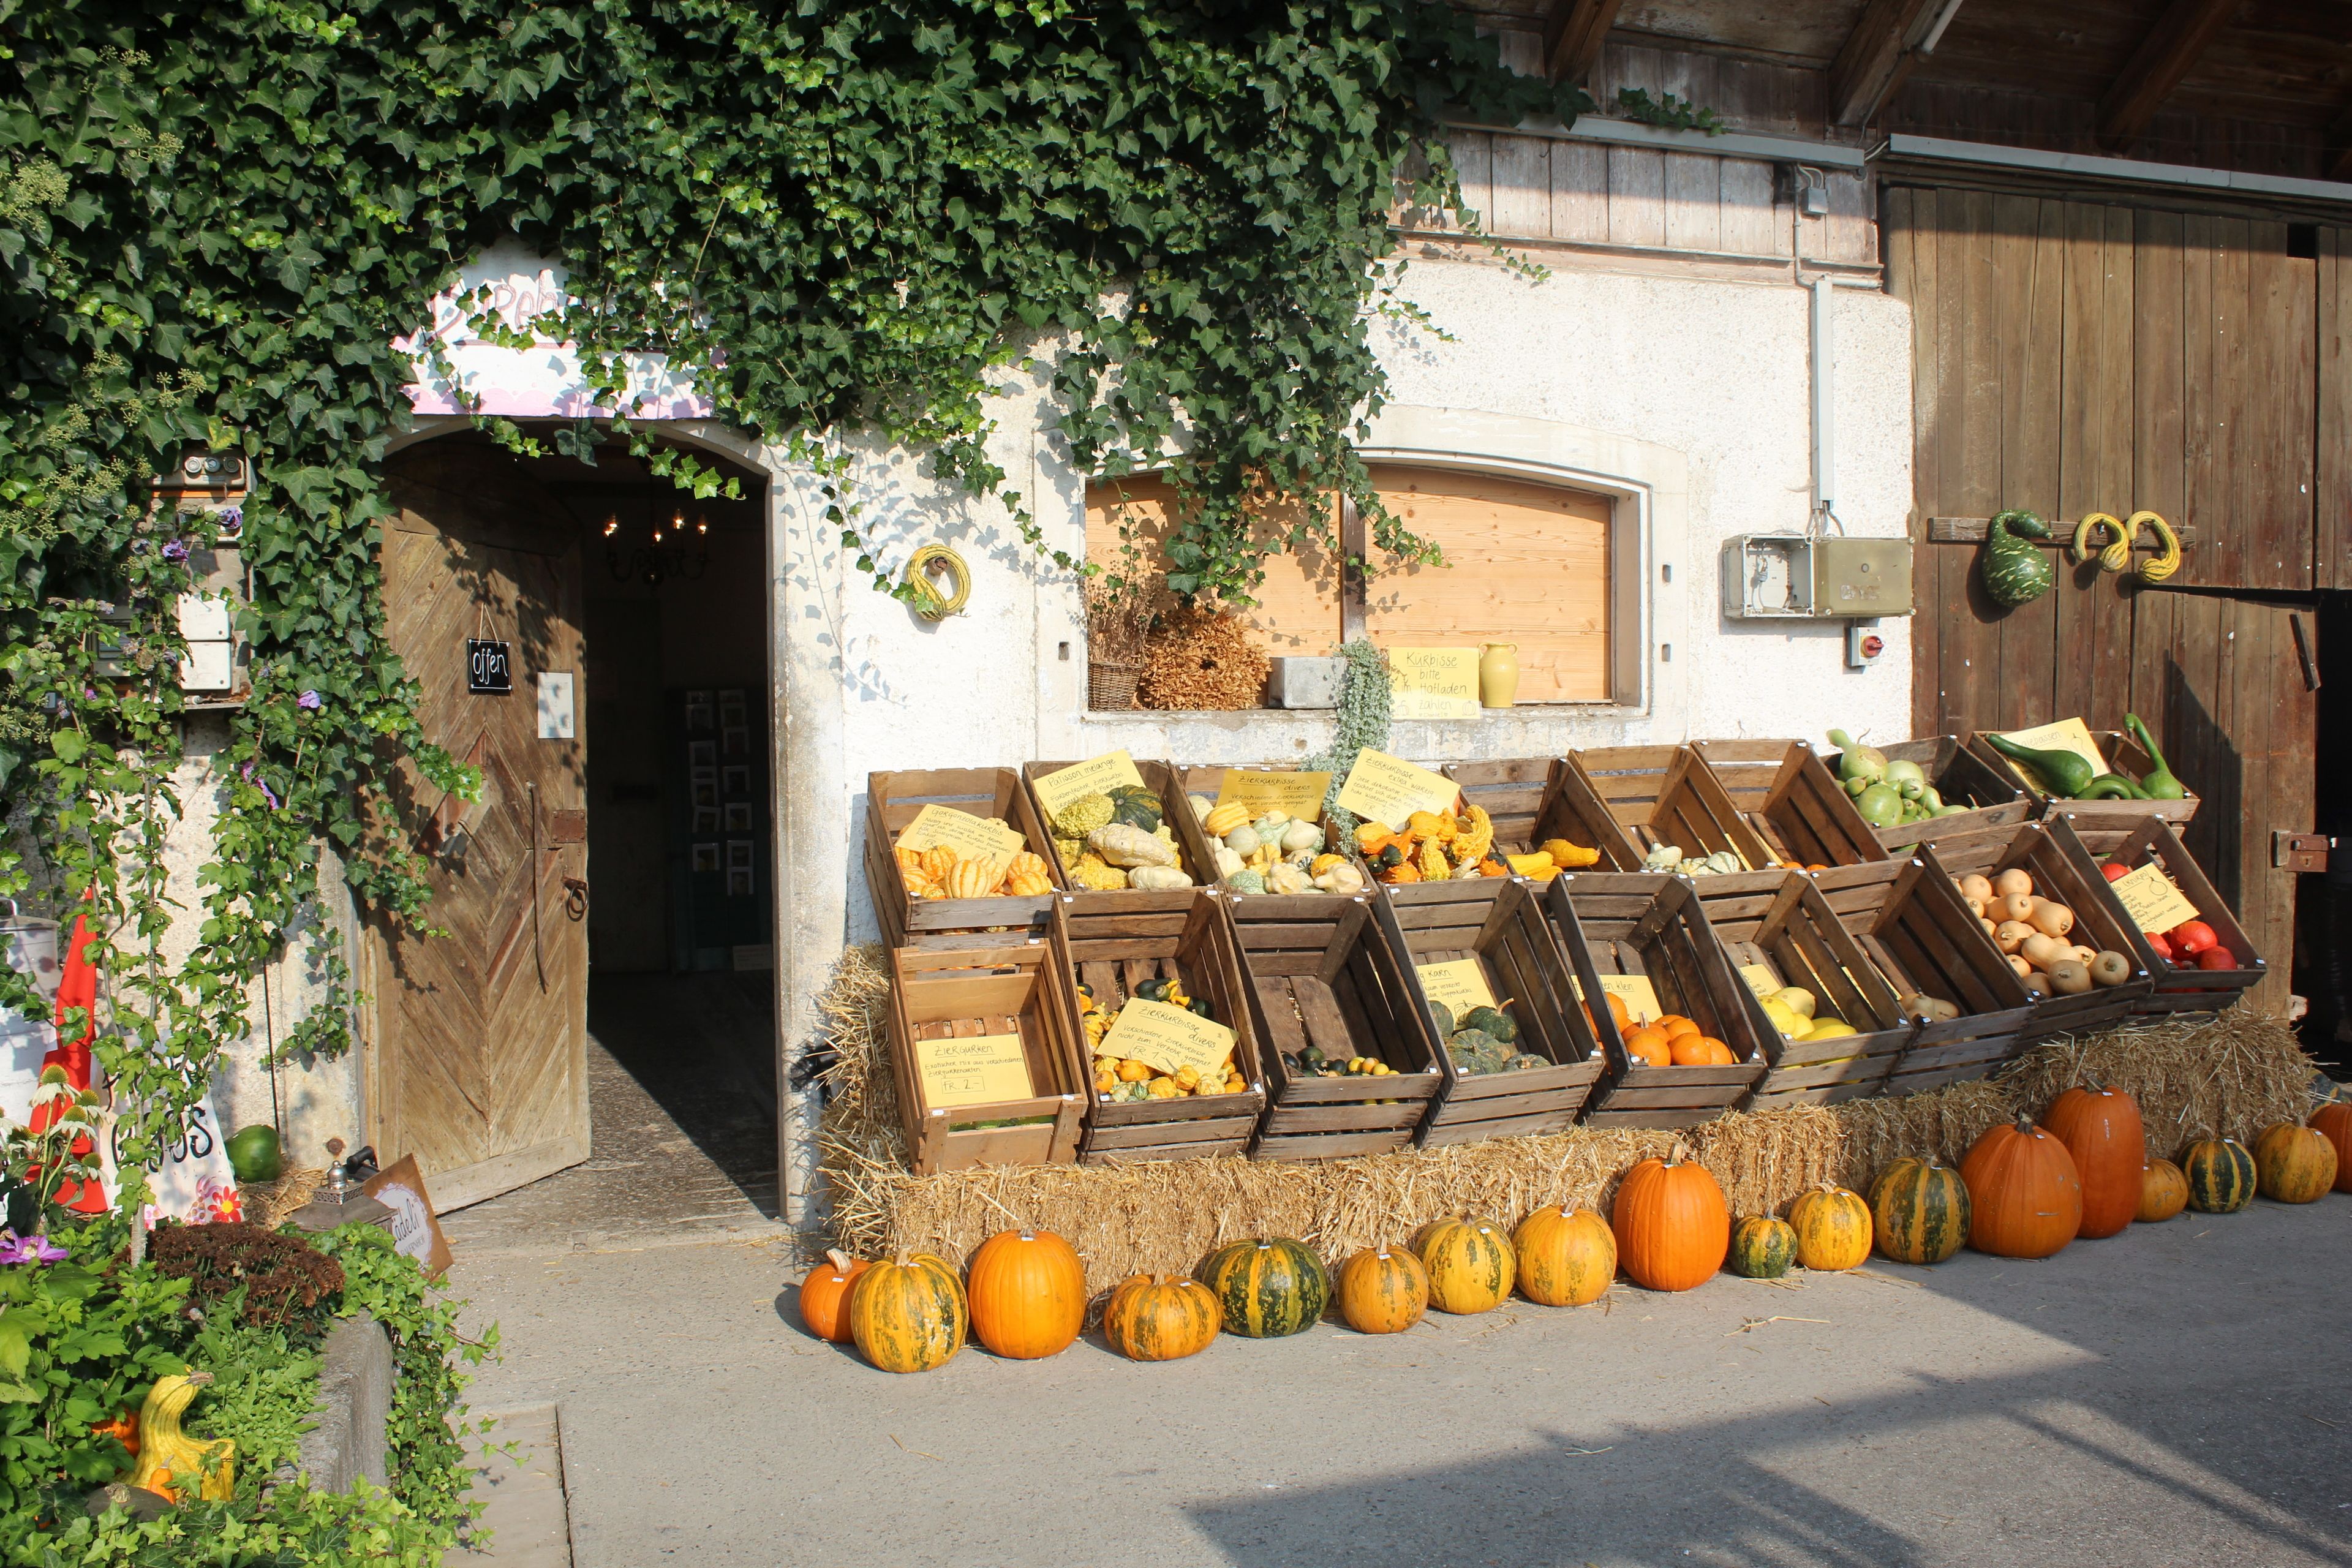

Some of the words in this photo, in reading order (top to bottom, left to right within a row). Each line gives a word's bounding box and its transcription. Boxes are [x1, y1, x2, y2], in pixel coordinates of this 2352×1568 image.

[472, 648, 508, 684] offen
[1419, 669, 1441, 680] bitte
[1420, 682, 1467, 695] Hofladen
[1419, 698, 1452, 710] zahlen
[1084, 758, 1117, 774] melange
[1117, 1031, 1135, 1040] nicht
[1136, 1036, 1152, 1045] zum
[1188, 1032, 1217, 1049] divers
